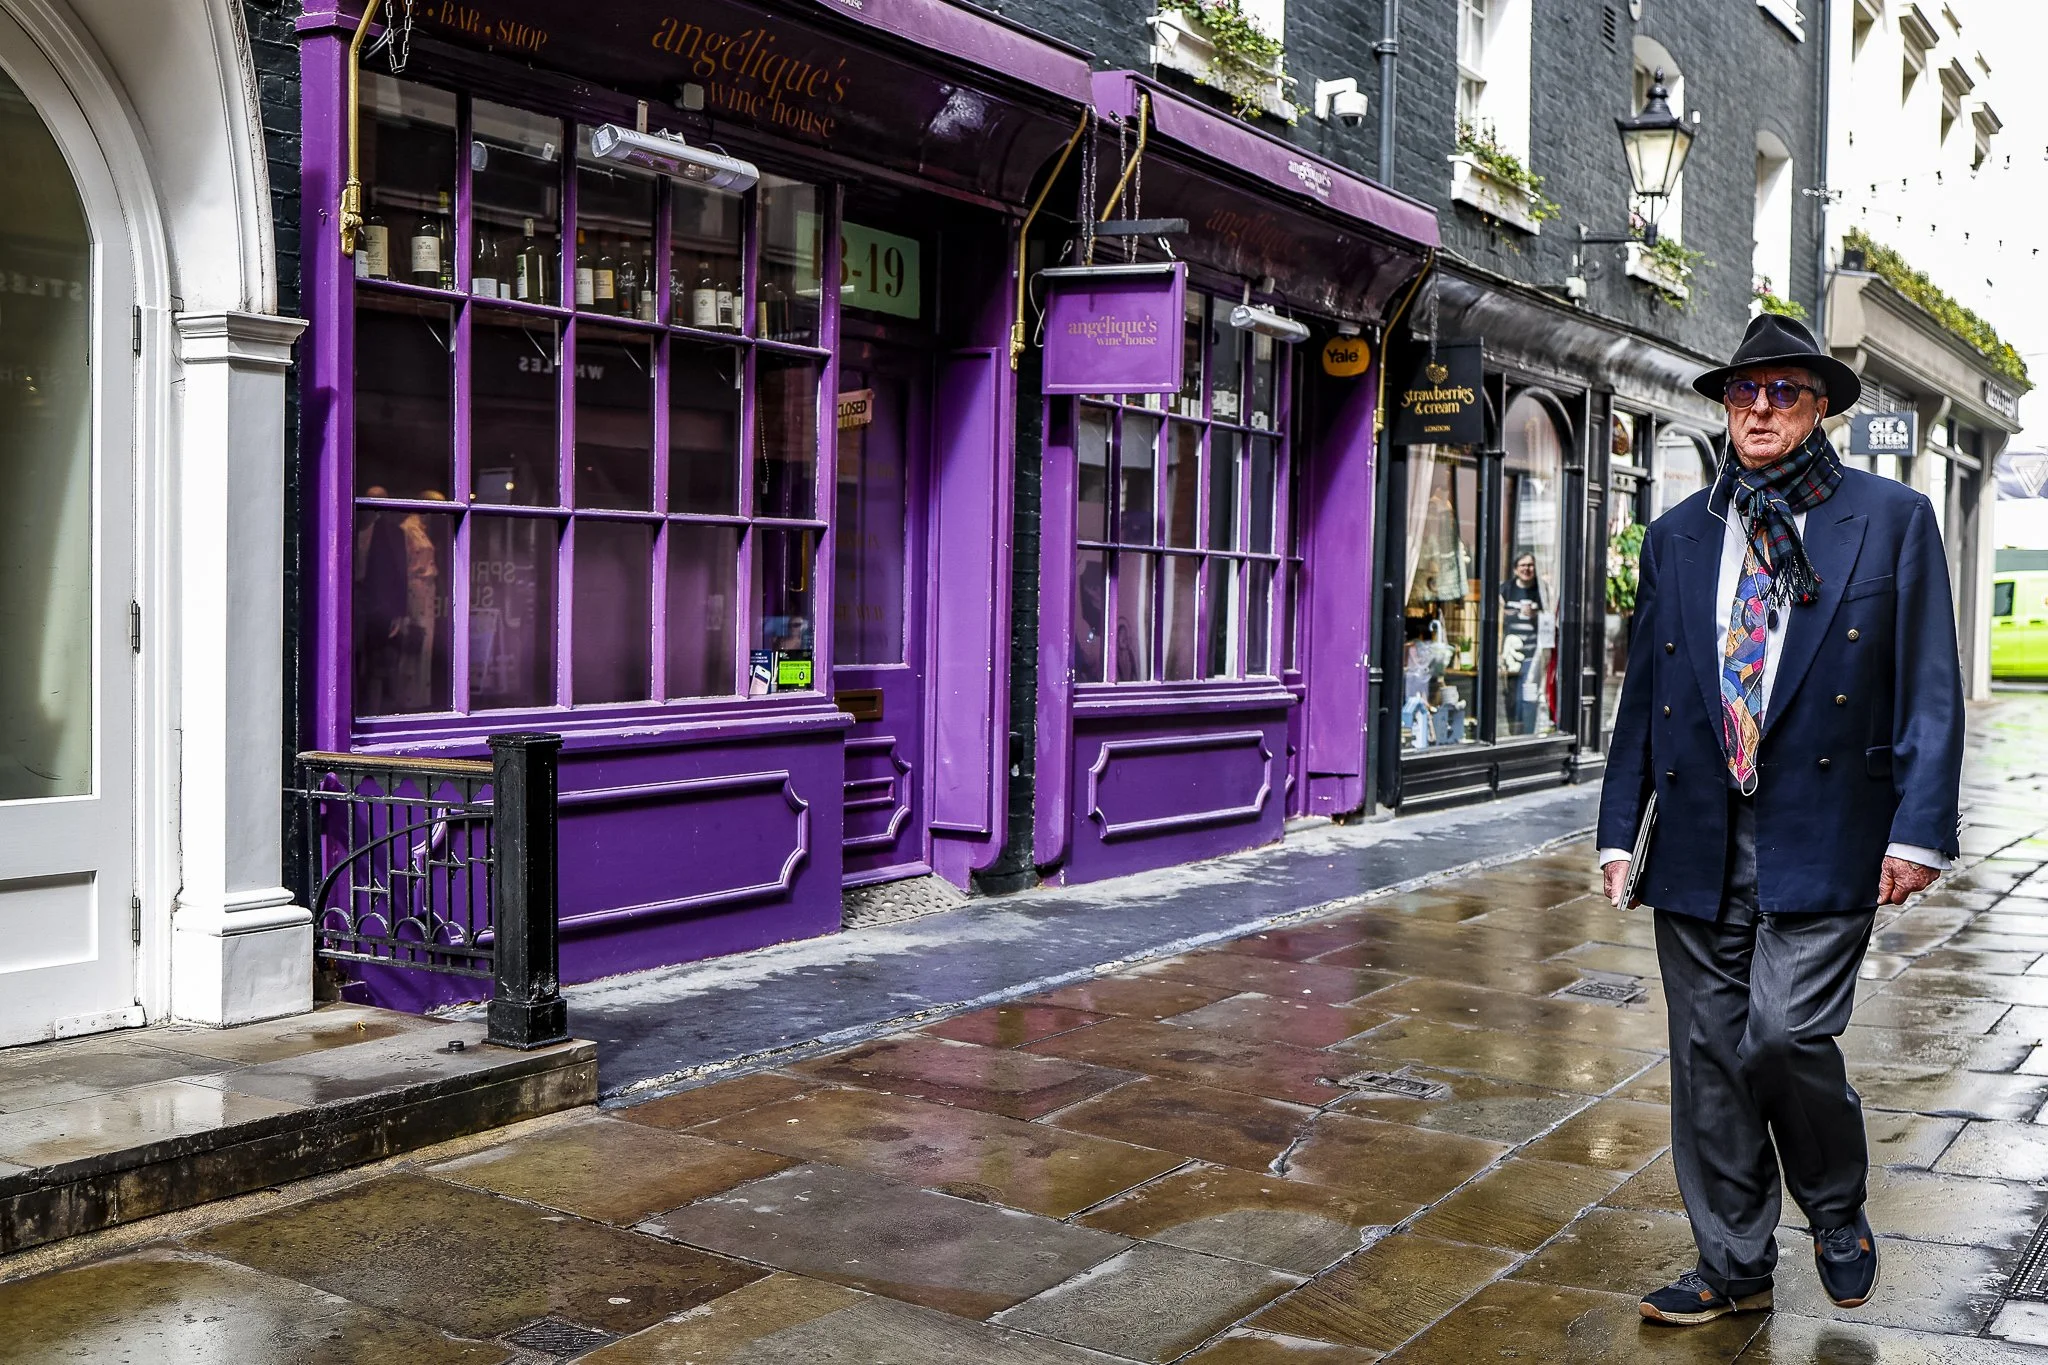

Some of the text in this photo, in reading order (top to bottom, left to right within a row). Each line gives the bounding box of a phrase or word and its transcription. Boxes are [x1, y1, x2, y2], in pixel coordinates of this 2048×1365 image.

[439, 0, 481, 34] BAR
[496, 19, 548, 52] SHOP
[651, 15, 851, 104] angélique's
[710, 77, 837, 138] wine house
[1068, 314, 1158, 339] angélique's
[1096, 332, 1157, 346] wine house
[1325, 347, 1359, 364] Yale
[1424, 401, 1460, 414] cream
